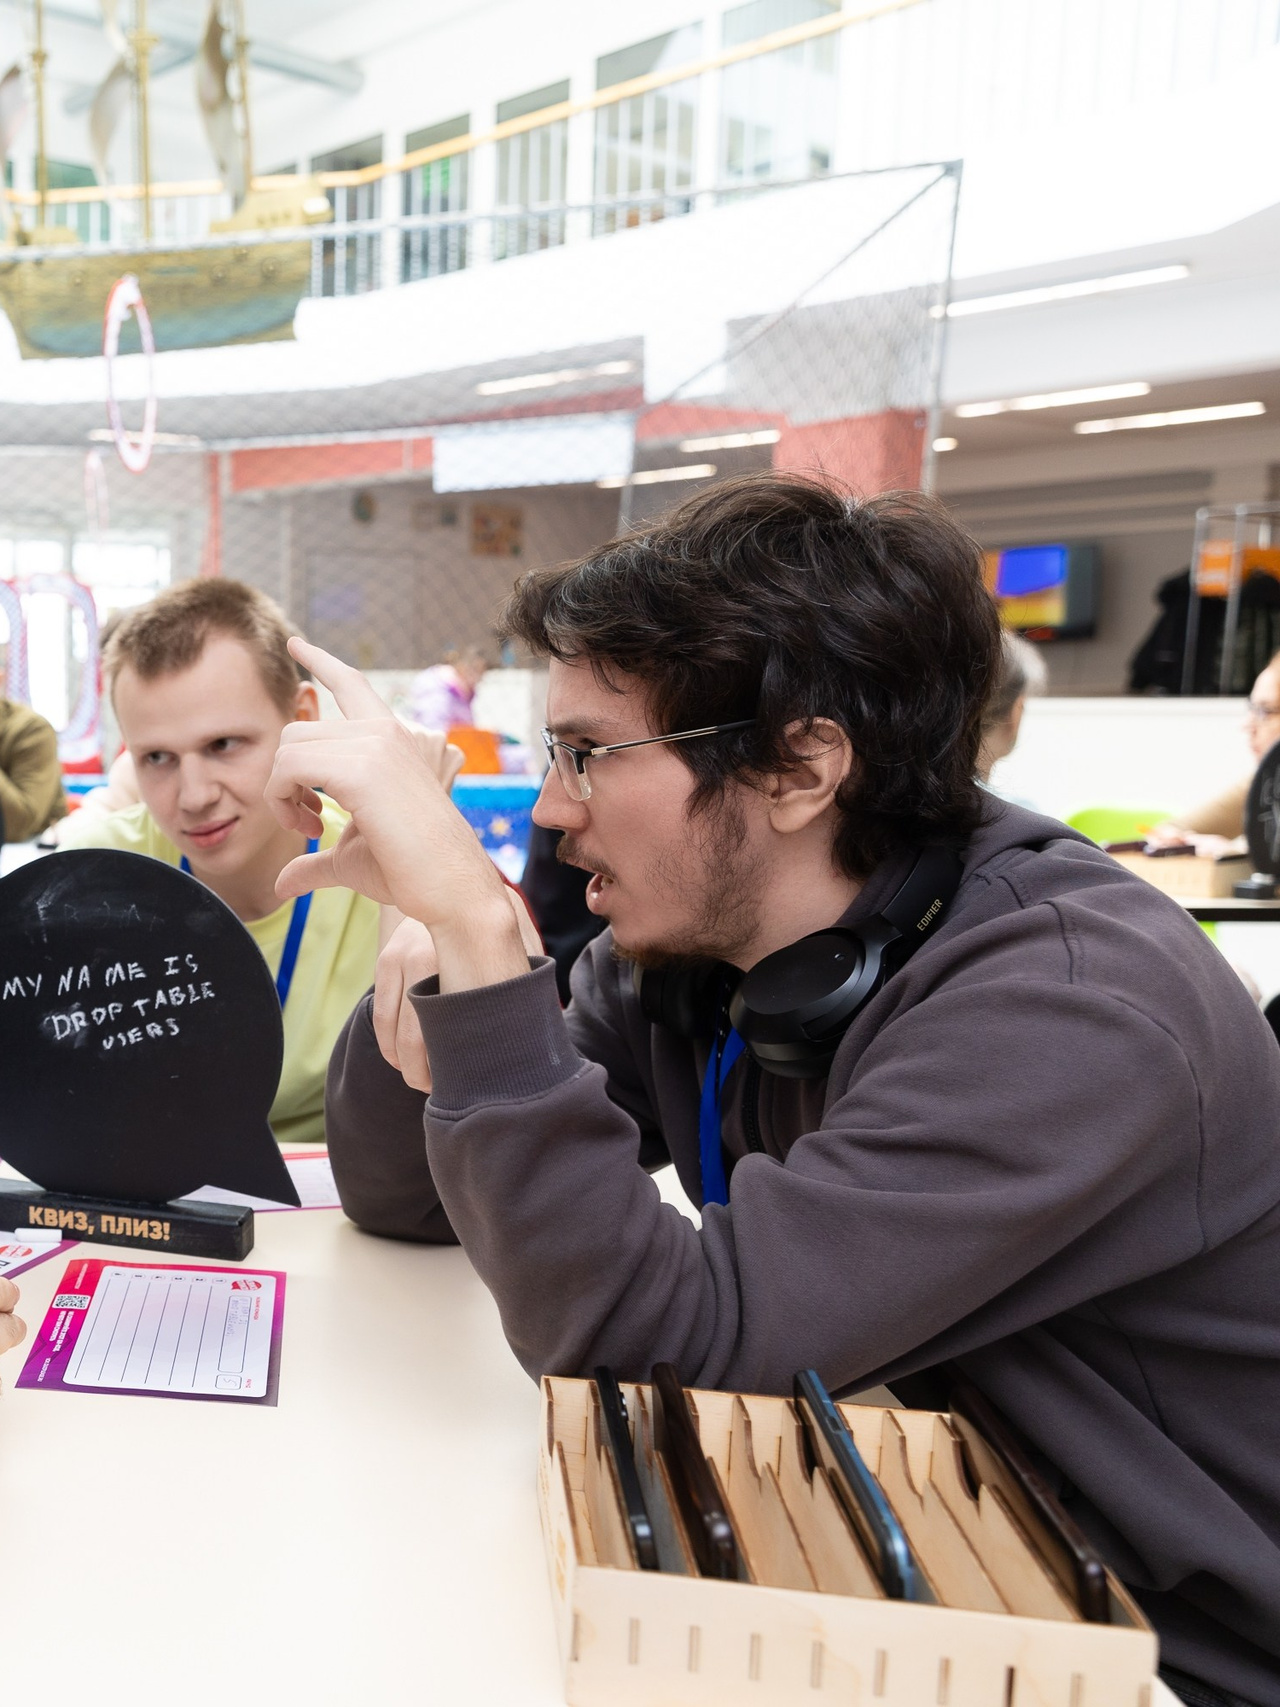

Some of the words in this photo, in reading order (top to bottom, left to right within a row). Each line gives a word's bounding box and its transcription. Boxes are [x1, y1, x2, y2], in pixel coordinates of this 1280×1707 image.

[916, 899, 943, 931] EDIFIER
[2, 973, 43, 1000] MY
[163, 953, 199, 976] IS
[51, 1002, 124, 1041] DROP
[131, 981, 216, 1017] TABLE
[28, 1205, 95, 1235] КВИЗ,
[100, 1214, 171, 1241] ПЛИЗ!
